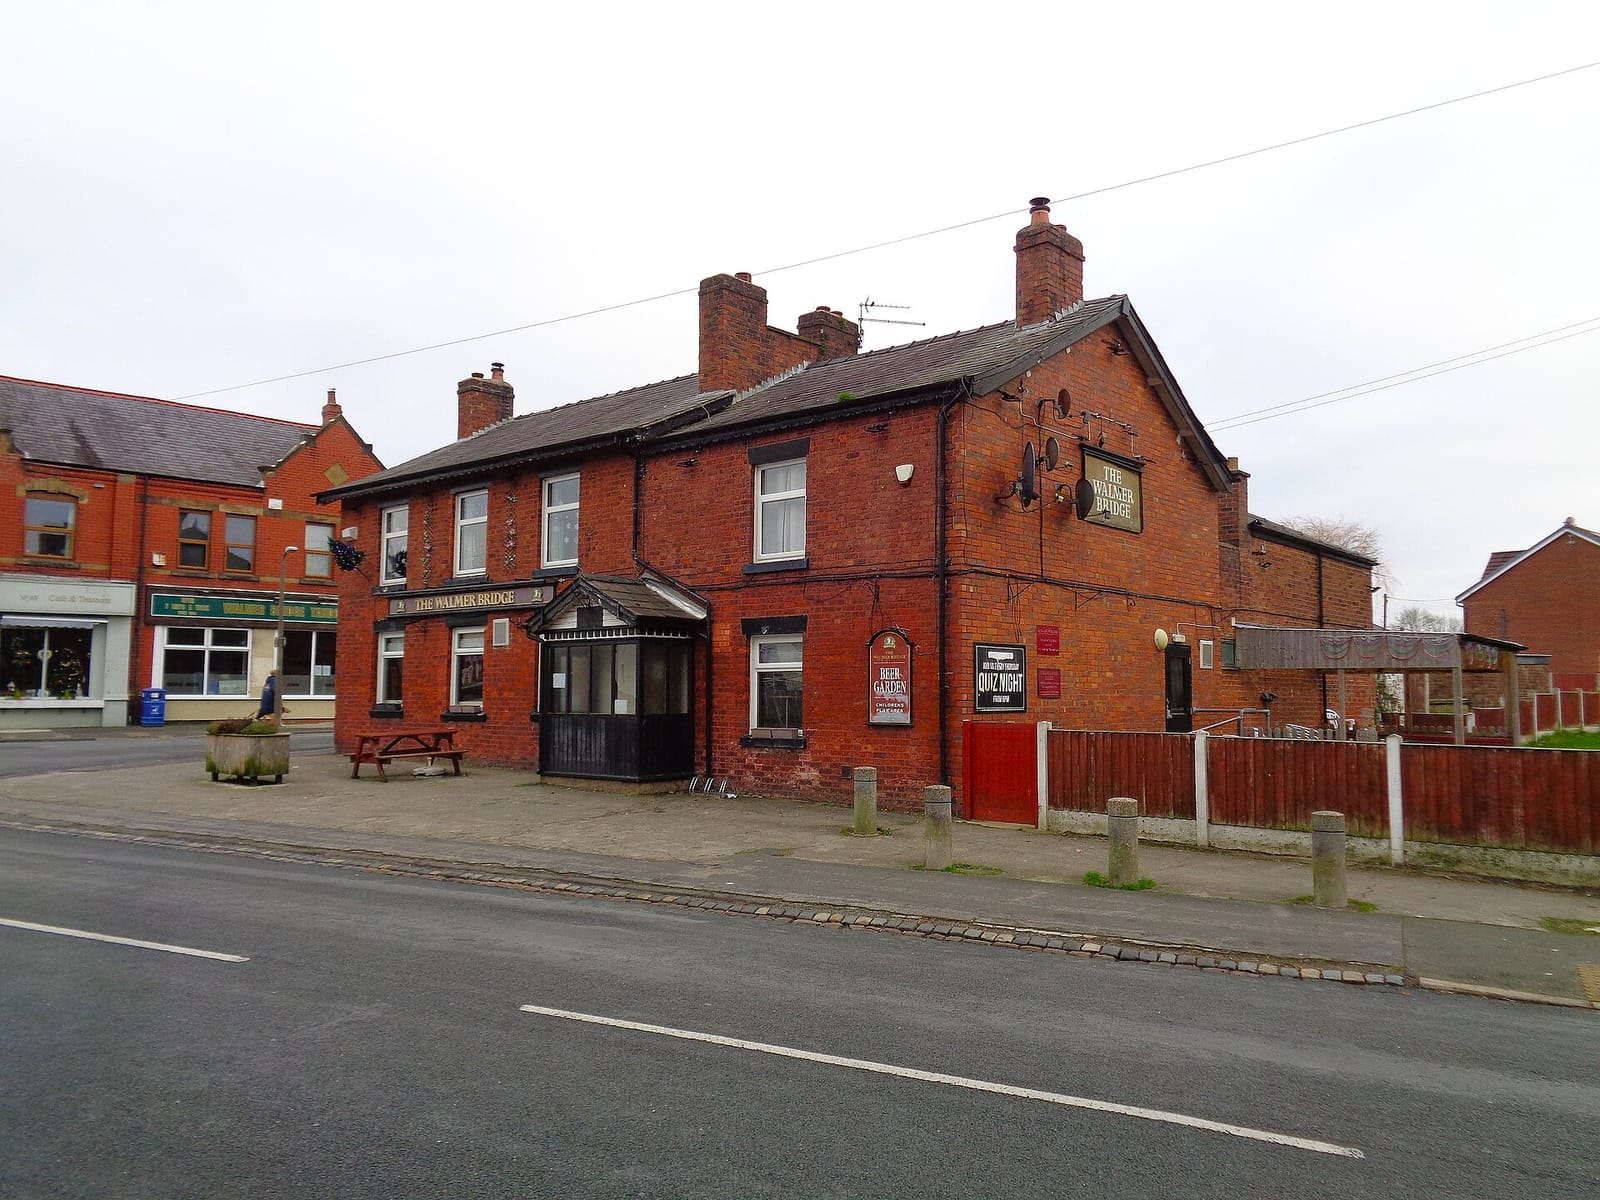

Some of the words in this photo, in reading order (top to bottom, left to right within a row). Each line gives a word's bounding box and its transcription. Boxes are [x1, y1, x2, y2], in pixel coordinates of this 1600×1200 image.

[1104, 466, 1121, 484] THE
[1092, 479, 1134, 504] WALMER
[1096, 497, 1131, 518] BRIDGE
[415, 598, 433, 611] THE
[435, 595, 476, 609] WALMER
[478, 591, 514, 606] BRIDGE
[880, 668, 900, 680] BEER
[978, 672, 998, 692] QUIZ
[999, 673, 1023, 693] NIGHT
[873, 681, 907, 693] GARDEN
